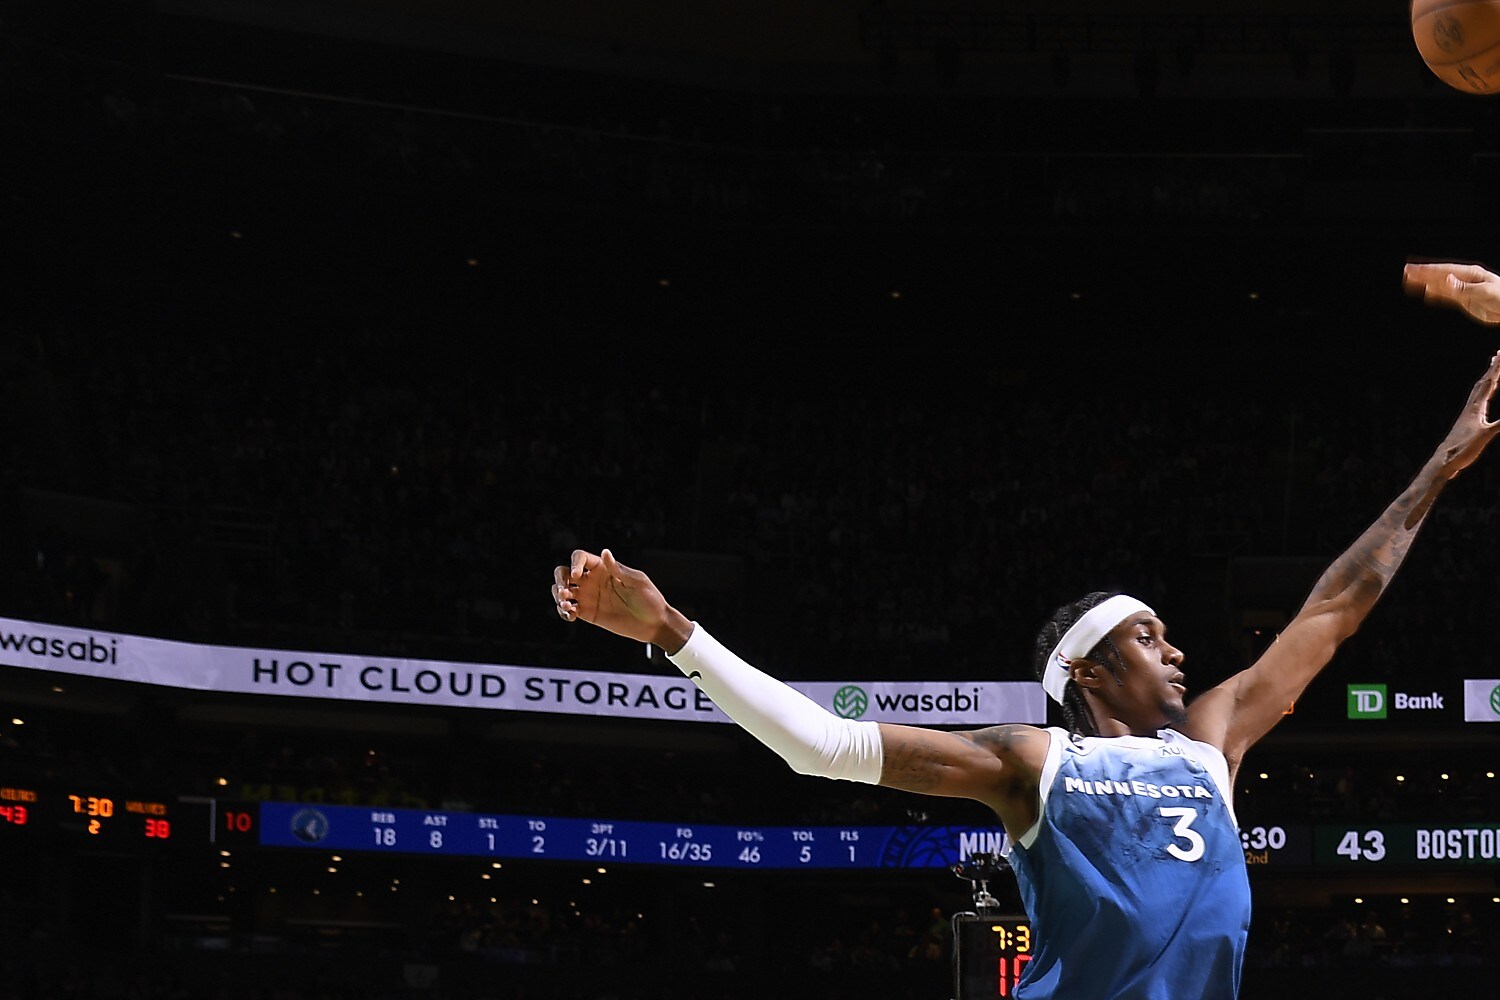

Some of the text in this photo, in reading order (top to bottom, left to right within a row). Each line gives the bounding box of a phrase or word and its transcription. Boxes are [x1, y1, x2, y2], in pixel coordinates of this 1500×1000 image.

[0, 631, 118, 665] wasabi
[253, 659, 714, 712] HOT CLOUD STORAGE
[875, 687, 979, 712] wasabi
[1350, 689, 1444, 713] TD Bank
[1064, 776, 1213, 799] MINNESOTA
[68, 795, 114, 818] 7:30
[145, 818, 171, 839] 38
[225, 812, 252, 832] 10
[423, 815, 447, 827] AST
[478, 818, 500, 829] STL
[528, 820, 546, 831] TO
[676, 828, 693, 839] FG
[792, 831, 814, 842] TOL
[840, 831, 859, 841] FLS
[374, 828, 855, 863] 18 8 1 2 3/11 16/35 46 5 1
[1159, 807, 1206, 862] 3
[1240, 826, 1287, 850] :30
[1336, 830, 1386, 862] 43
[1246, 851, 1269, 865] 2nd
